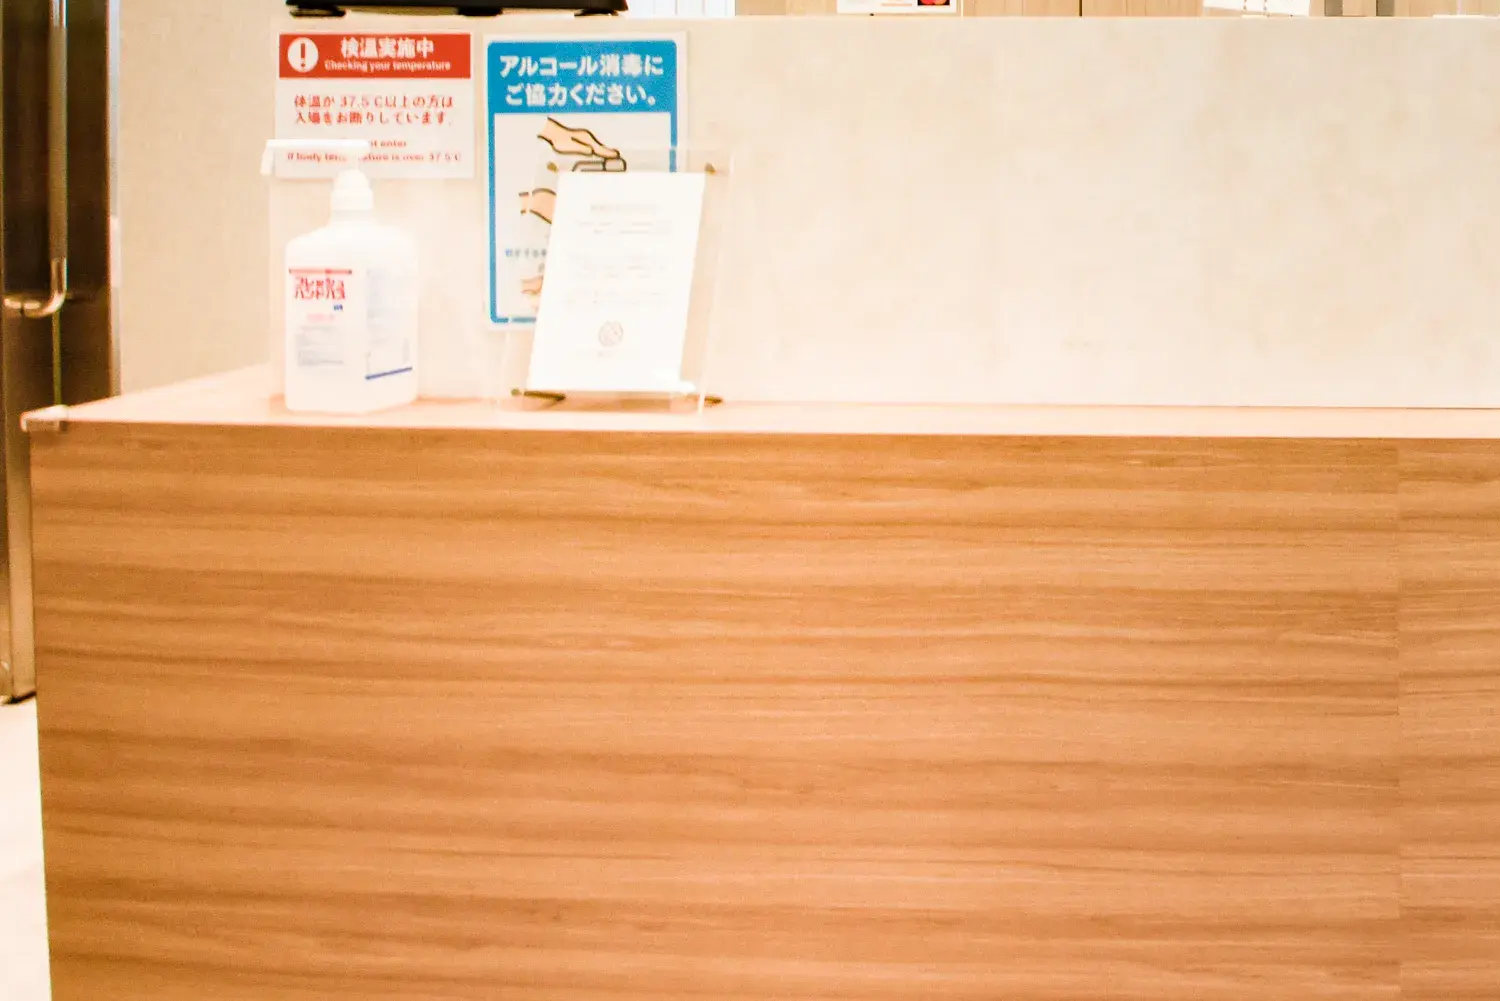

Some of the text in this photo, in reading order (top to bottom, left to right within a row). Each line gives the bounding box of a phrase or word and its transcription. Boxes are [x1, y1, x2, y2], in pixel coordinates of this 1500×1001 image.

[341, 37, 434, 58] 検温実施中
[325, 60, 451, 72] Checking your temperature
[500, 55, 663, 77] アルコール消毒に
[507, 83, 656, 107] ご協力ください。
